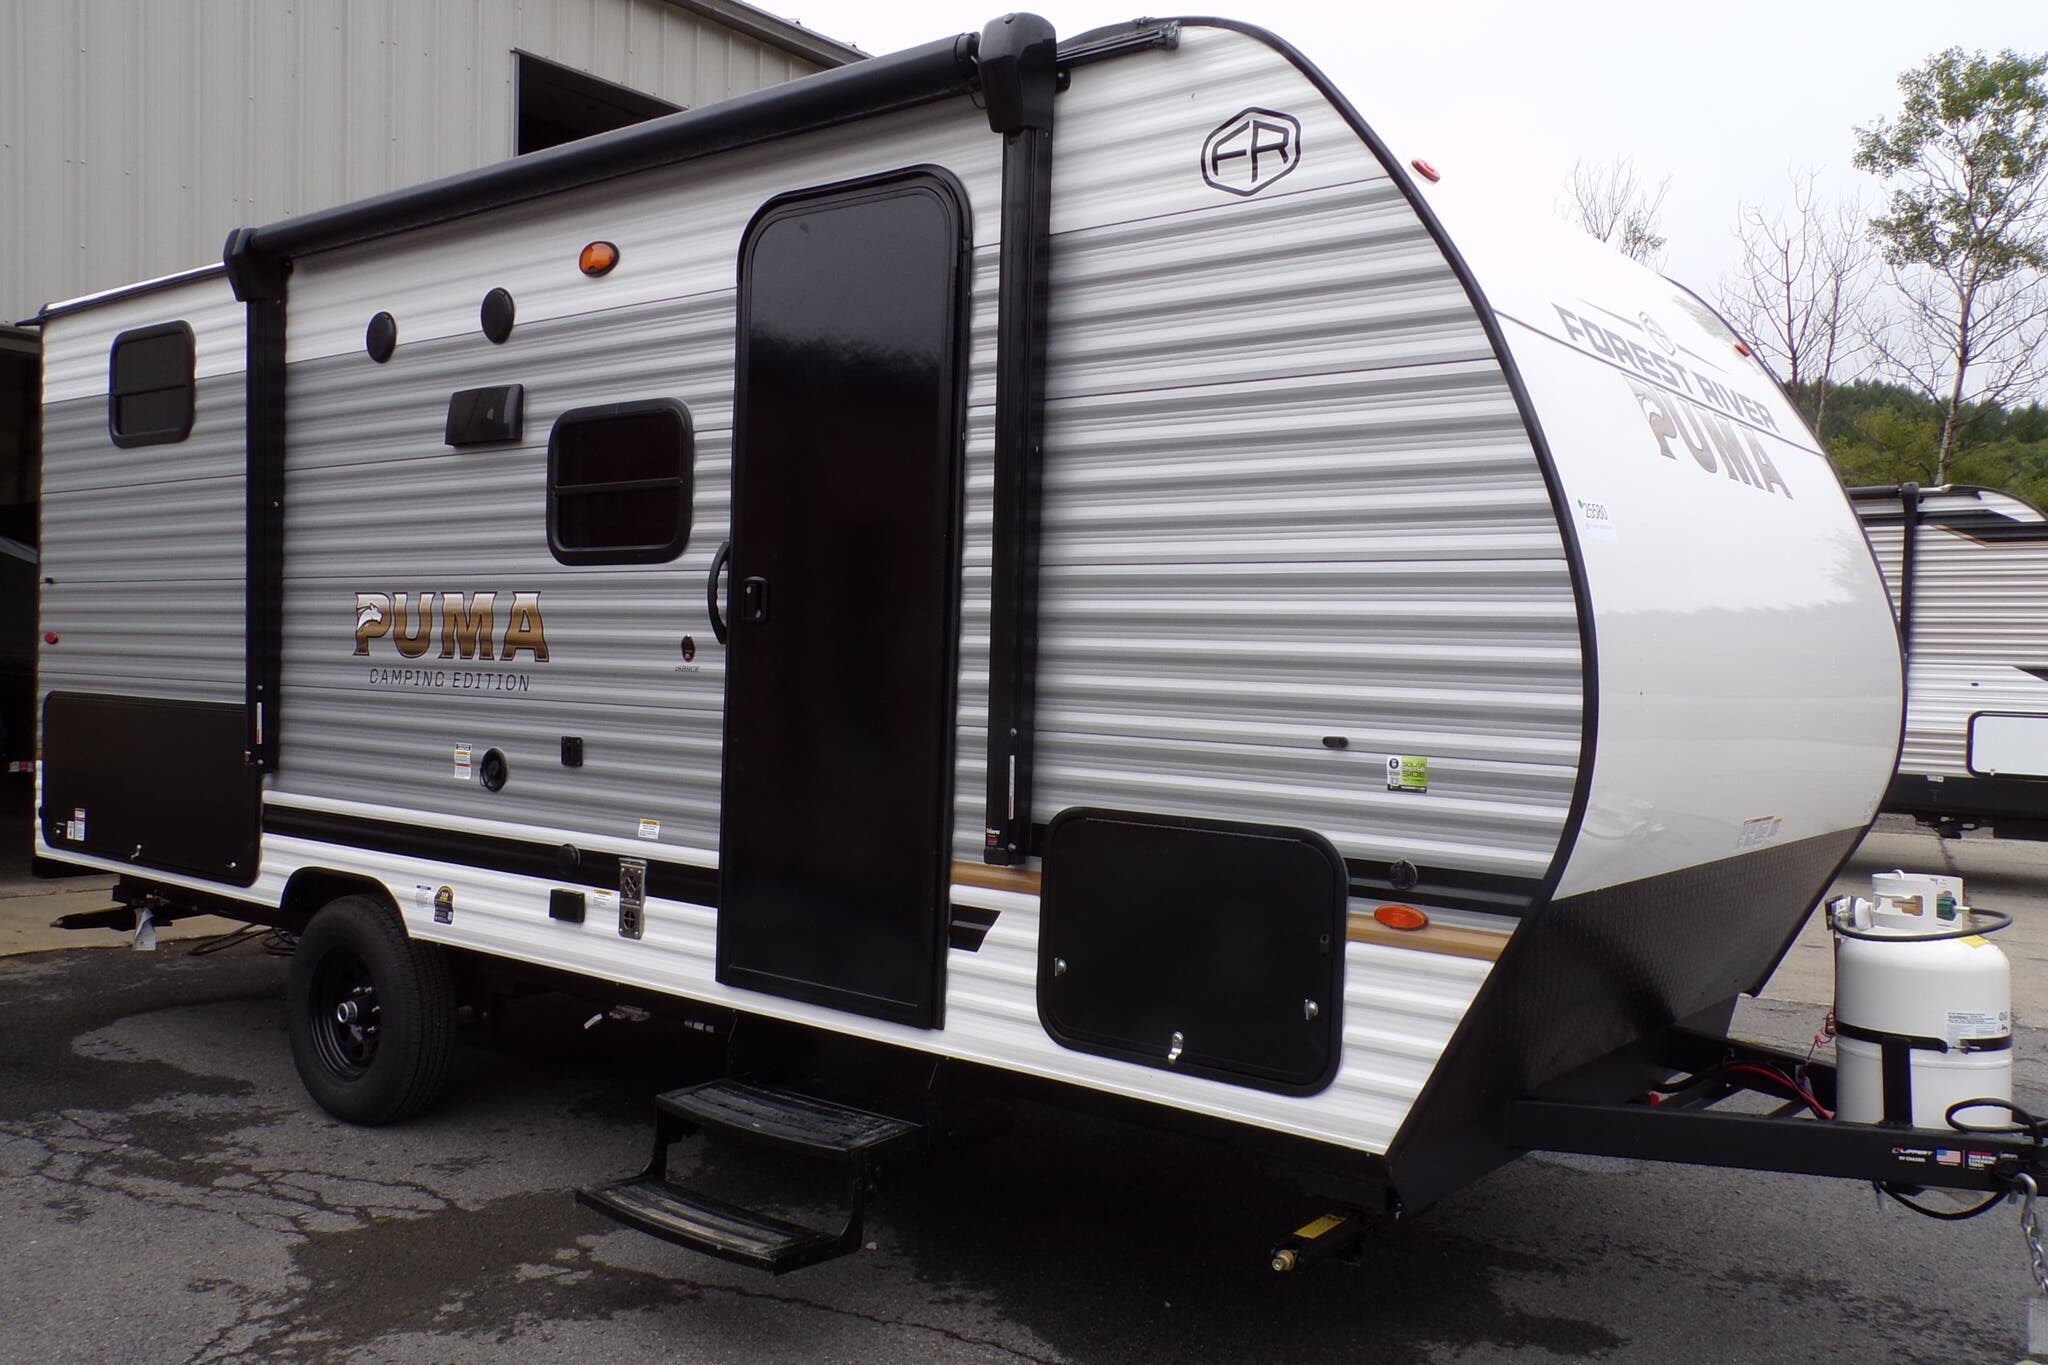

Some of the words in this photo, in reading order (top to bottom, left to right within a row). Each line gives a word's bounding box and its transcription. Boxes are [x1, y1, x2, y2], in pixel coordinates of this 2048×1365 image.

[1550, 301, 1694, 395] FOREST
[1690, 371, 1780, 433] RIVER
[1620, 372, 1794, 501] PUMA
[352, 591, 550, 663] PUMA
[369, 668, 445, 687] CAMPING
[452, 672, 530, 692] EDITION
